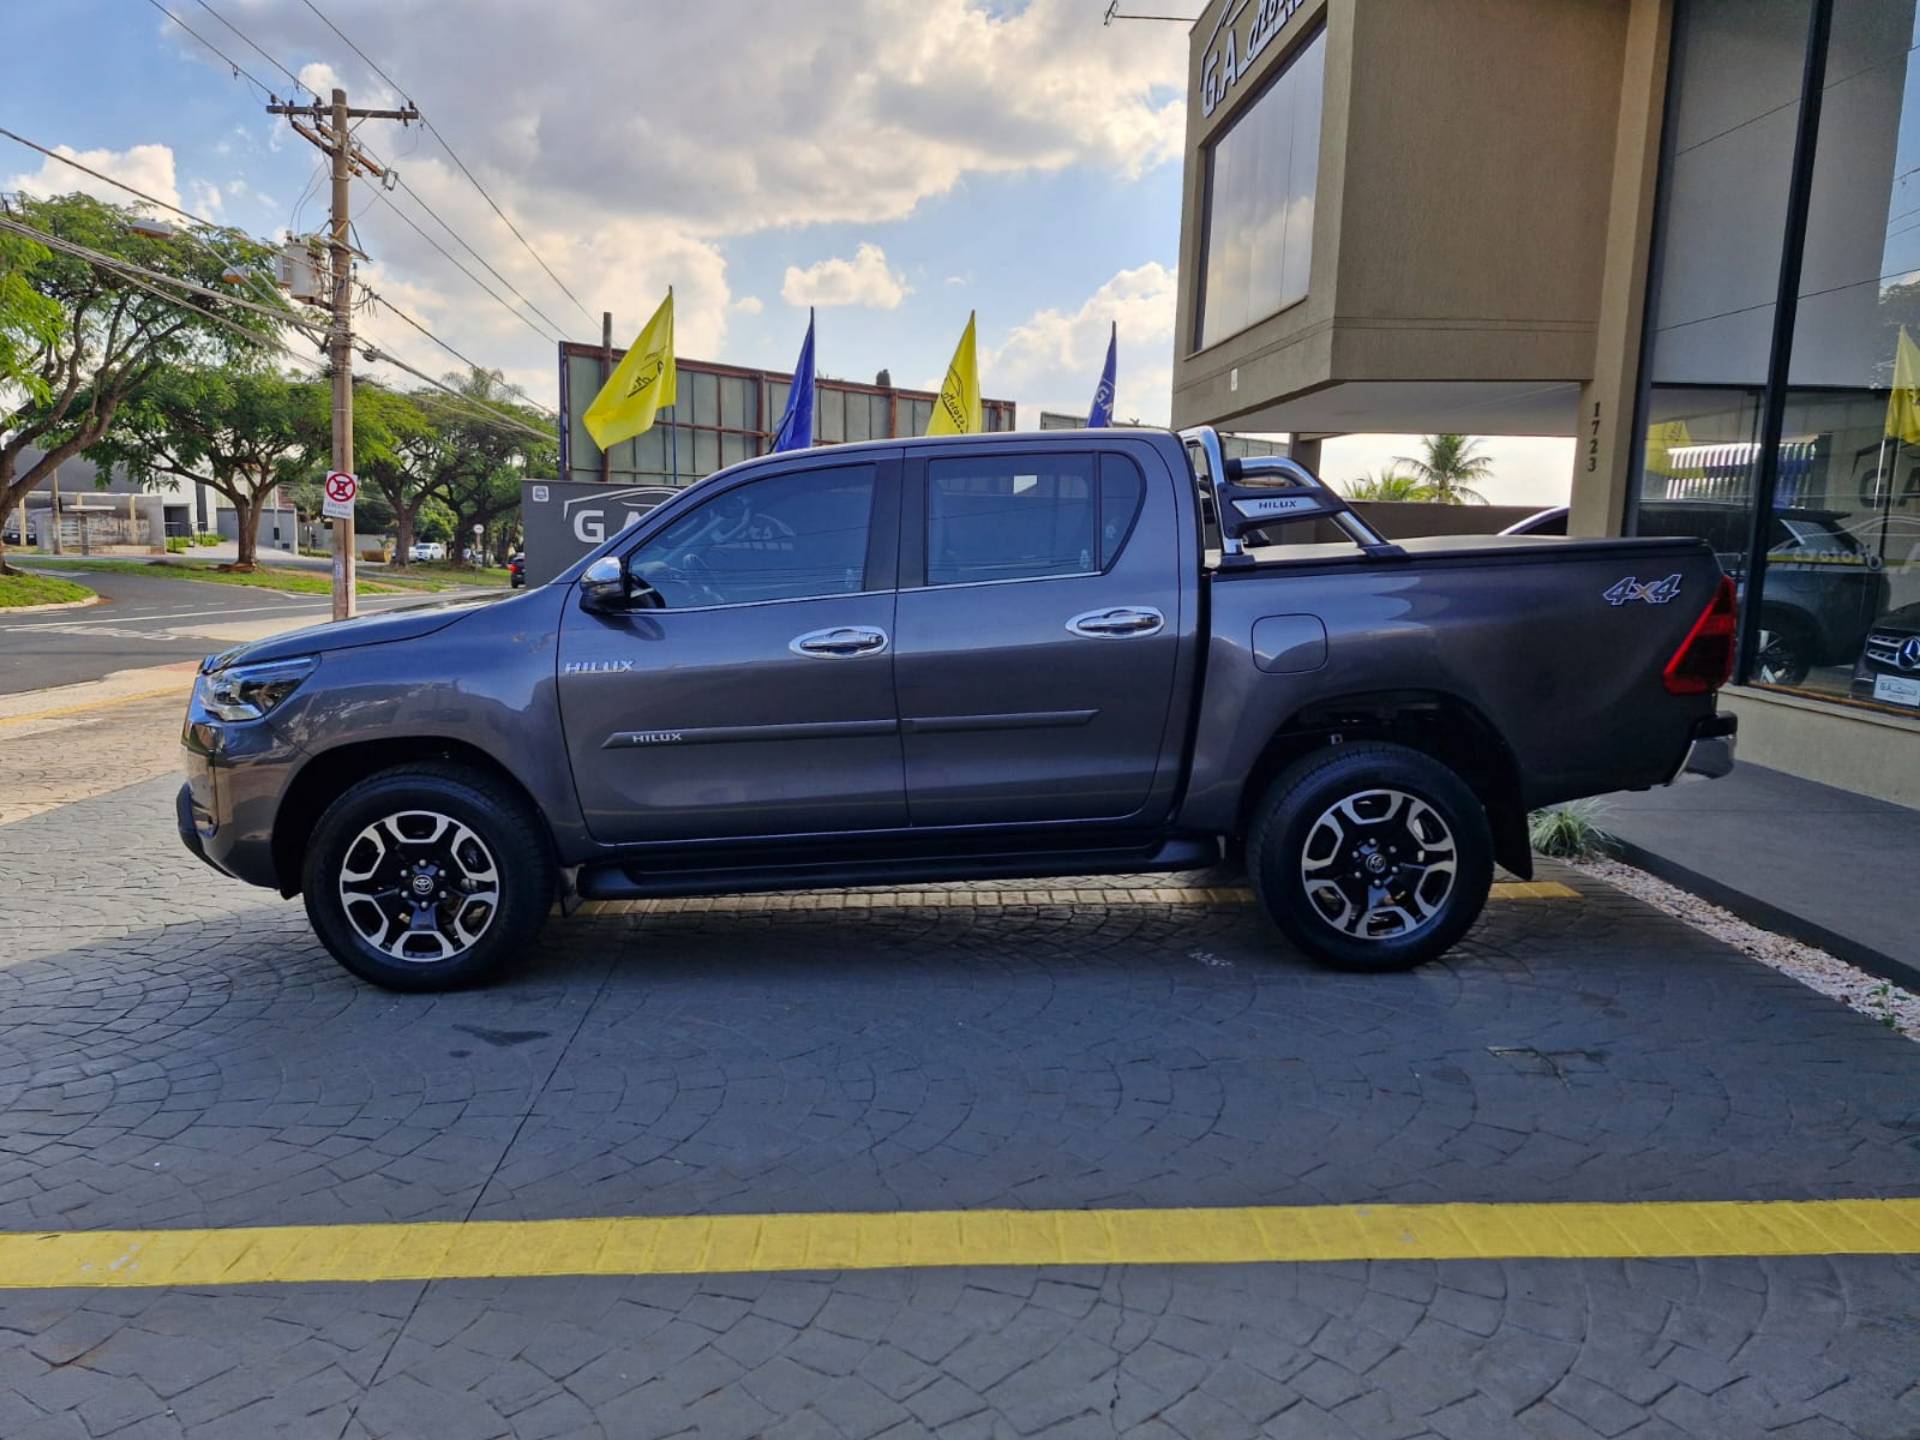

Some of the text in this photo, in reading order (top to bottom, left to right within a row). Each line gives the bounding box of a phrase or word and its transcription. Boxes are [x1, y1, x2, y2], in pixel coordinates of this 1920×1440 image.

[1258, 500, 1297, 510] HILUX
[564, 659, 634, 673] HILUX
[632, 732, 682, 744] HILUX
